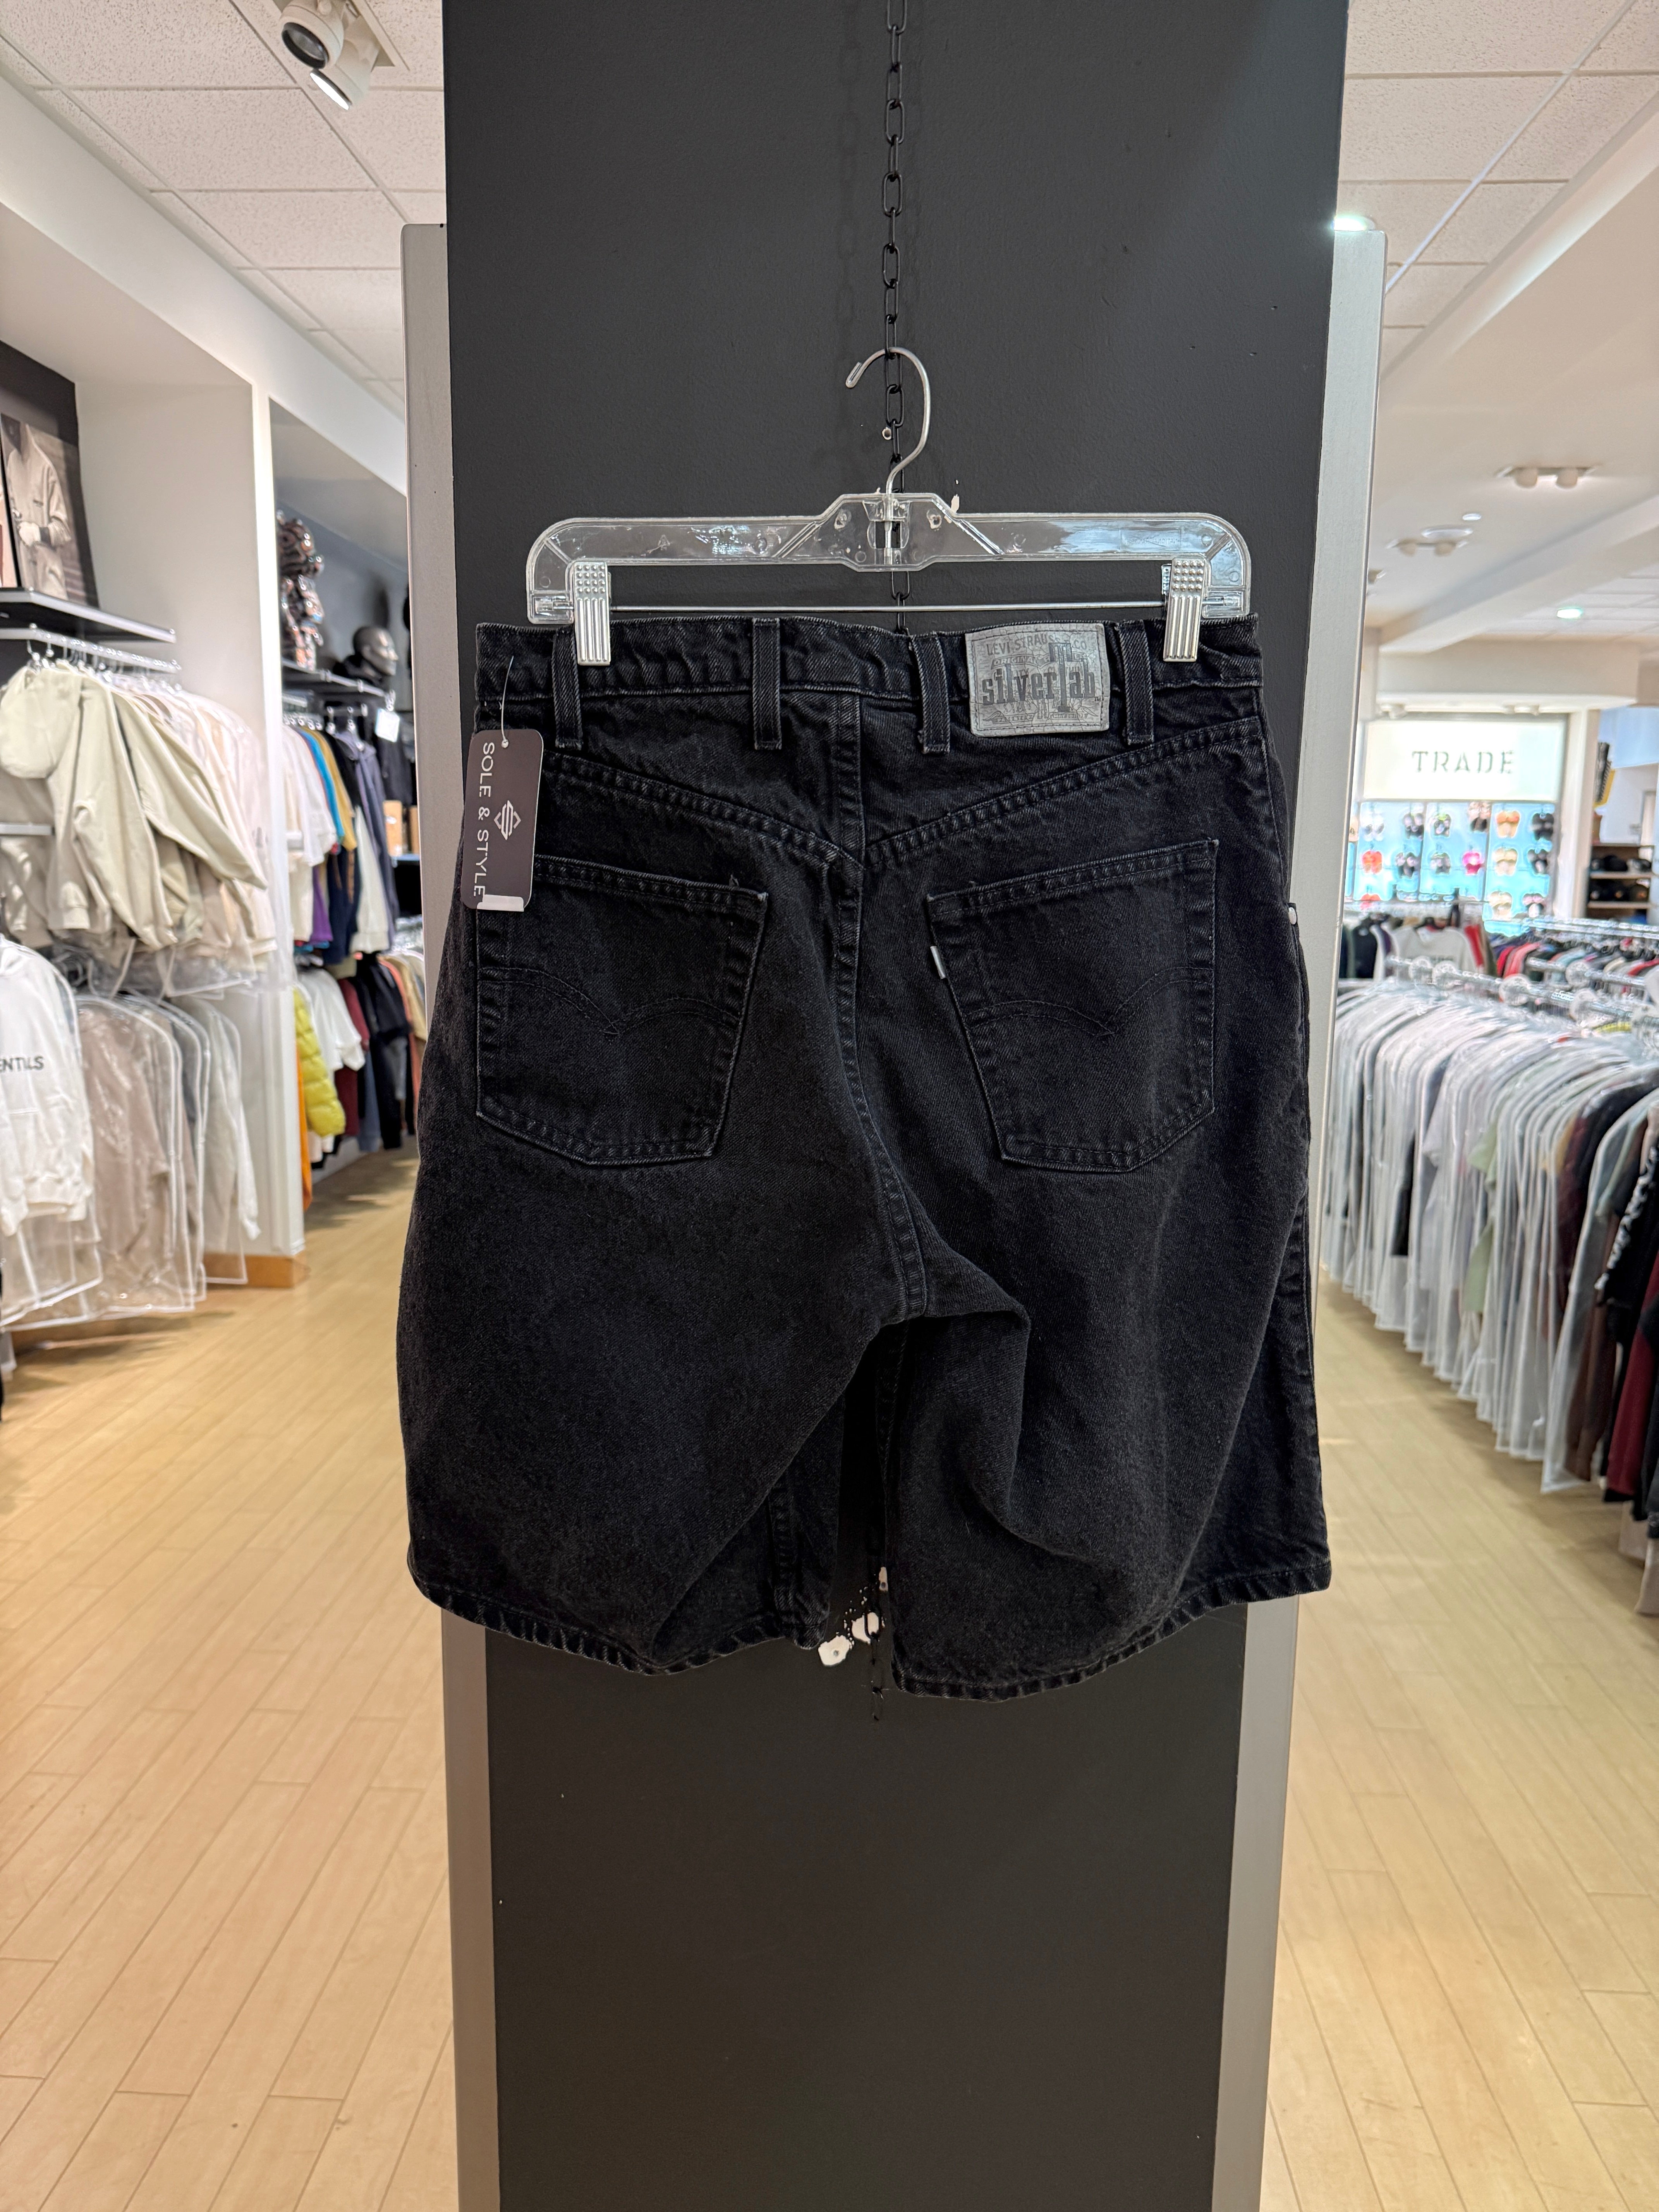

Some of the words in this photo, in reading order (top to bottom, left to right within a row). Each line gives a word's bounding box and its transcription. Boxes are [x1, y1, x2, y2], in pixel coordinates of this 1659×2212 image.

[986, 642, 1010, 656] LEVI
[479, 742, 495, 798] SOLE
[1412, 751, 1515, 774] TRADE
[478, 807, 490, 820] &
[473, 830, 489, 898] STYLE
